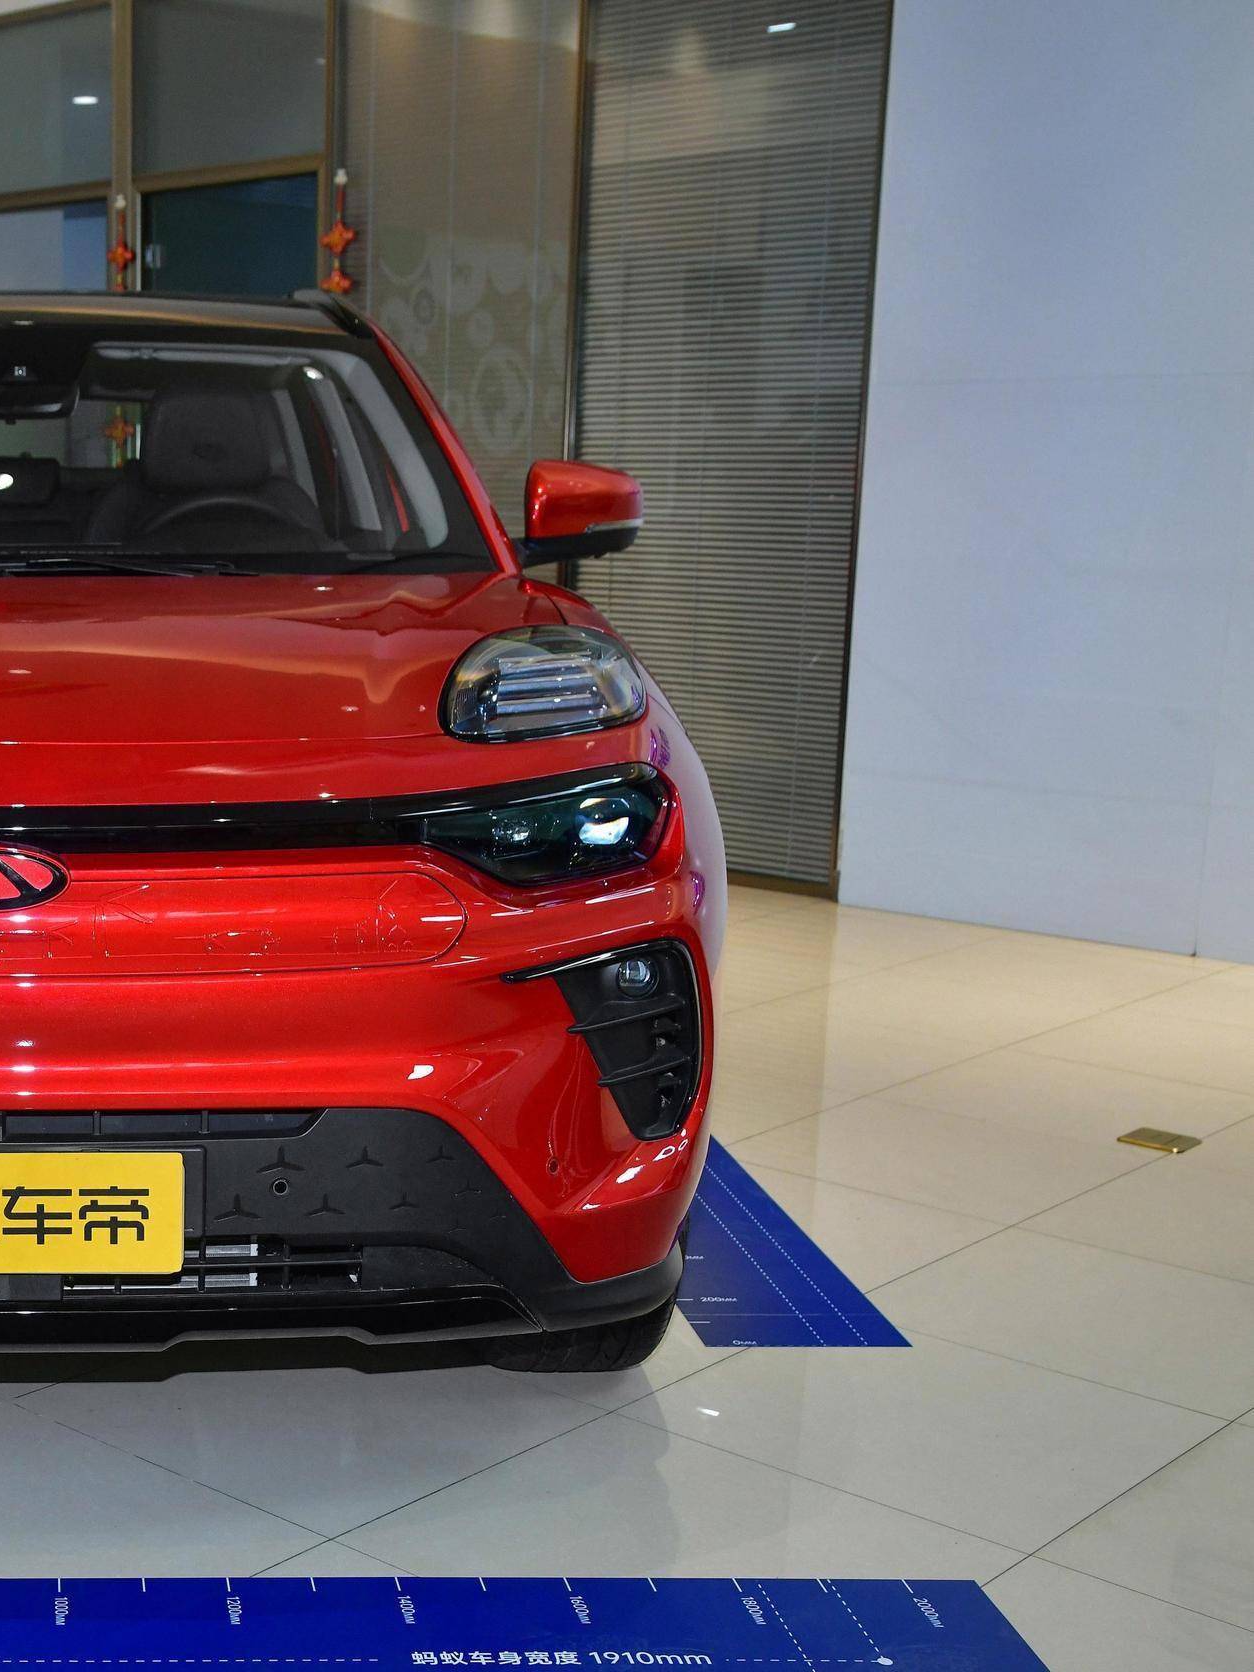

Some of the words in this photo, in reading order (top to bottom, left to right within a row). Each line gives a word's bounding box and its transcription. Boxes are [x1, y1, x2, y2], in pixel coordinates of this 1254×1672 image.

[411, 1651, 582, 1665] 蚂蚁车身宽度
[588, 1651, 713, 1665] 1910mm
